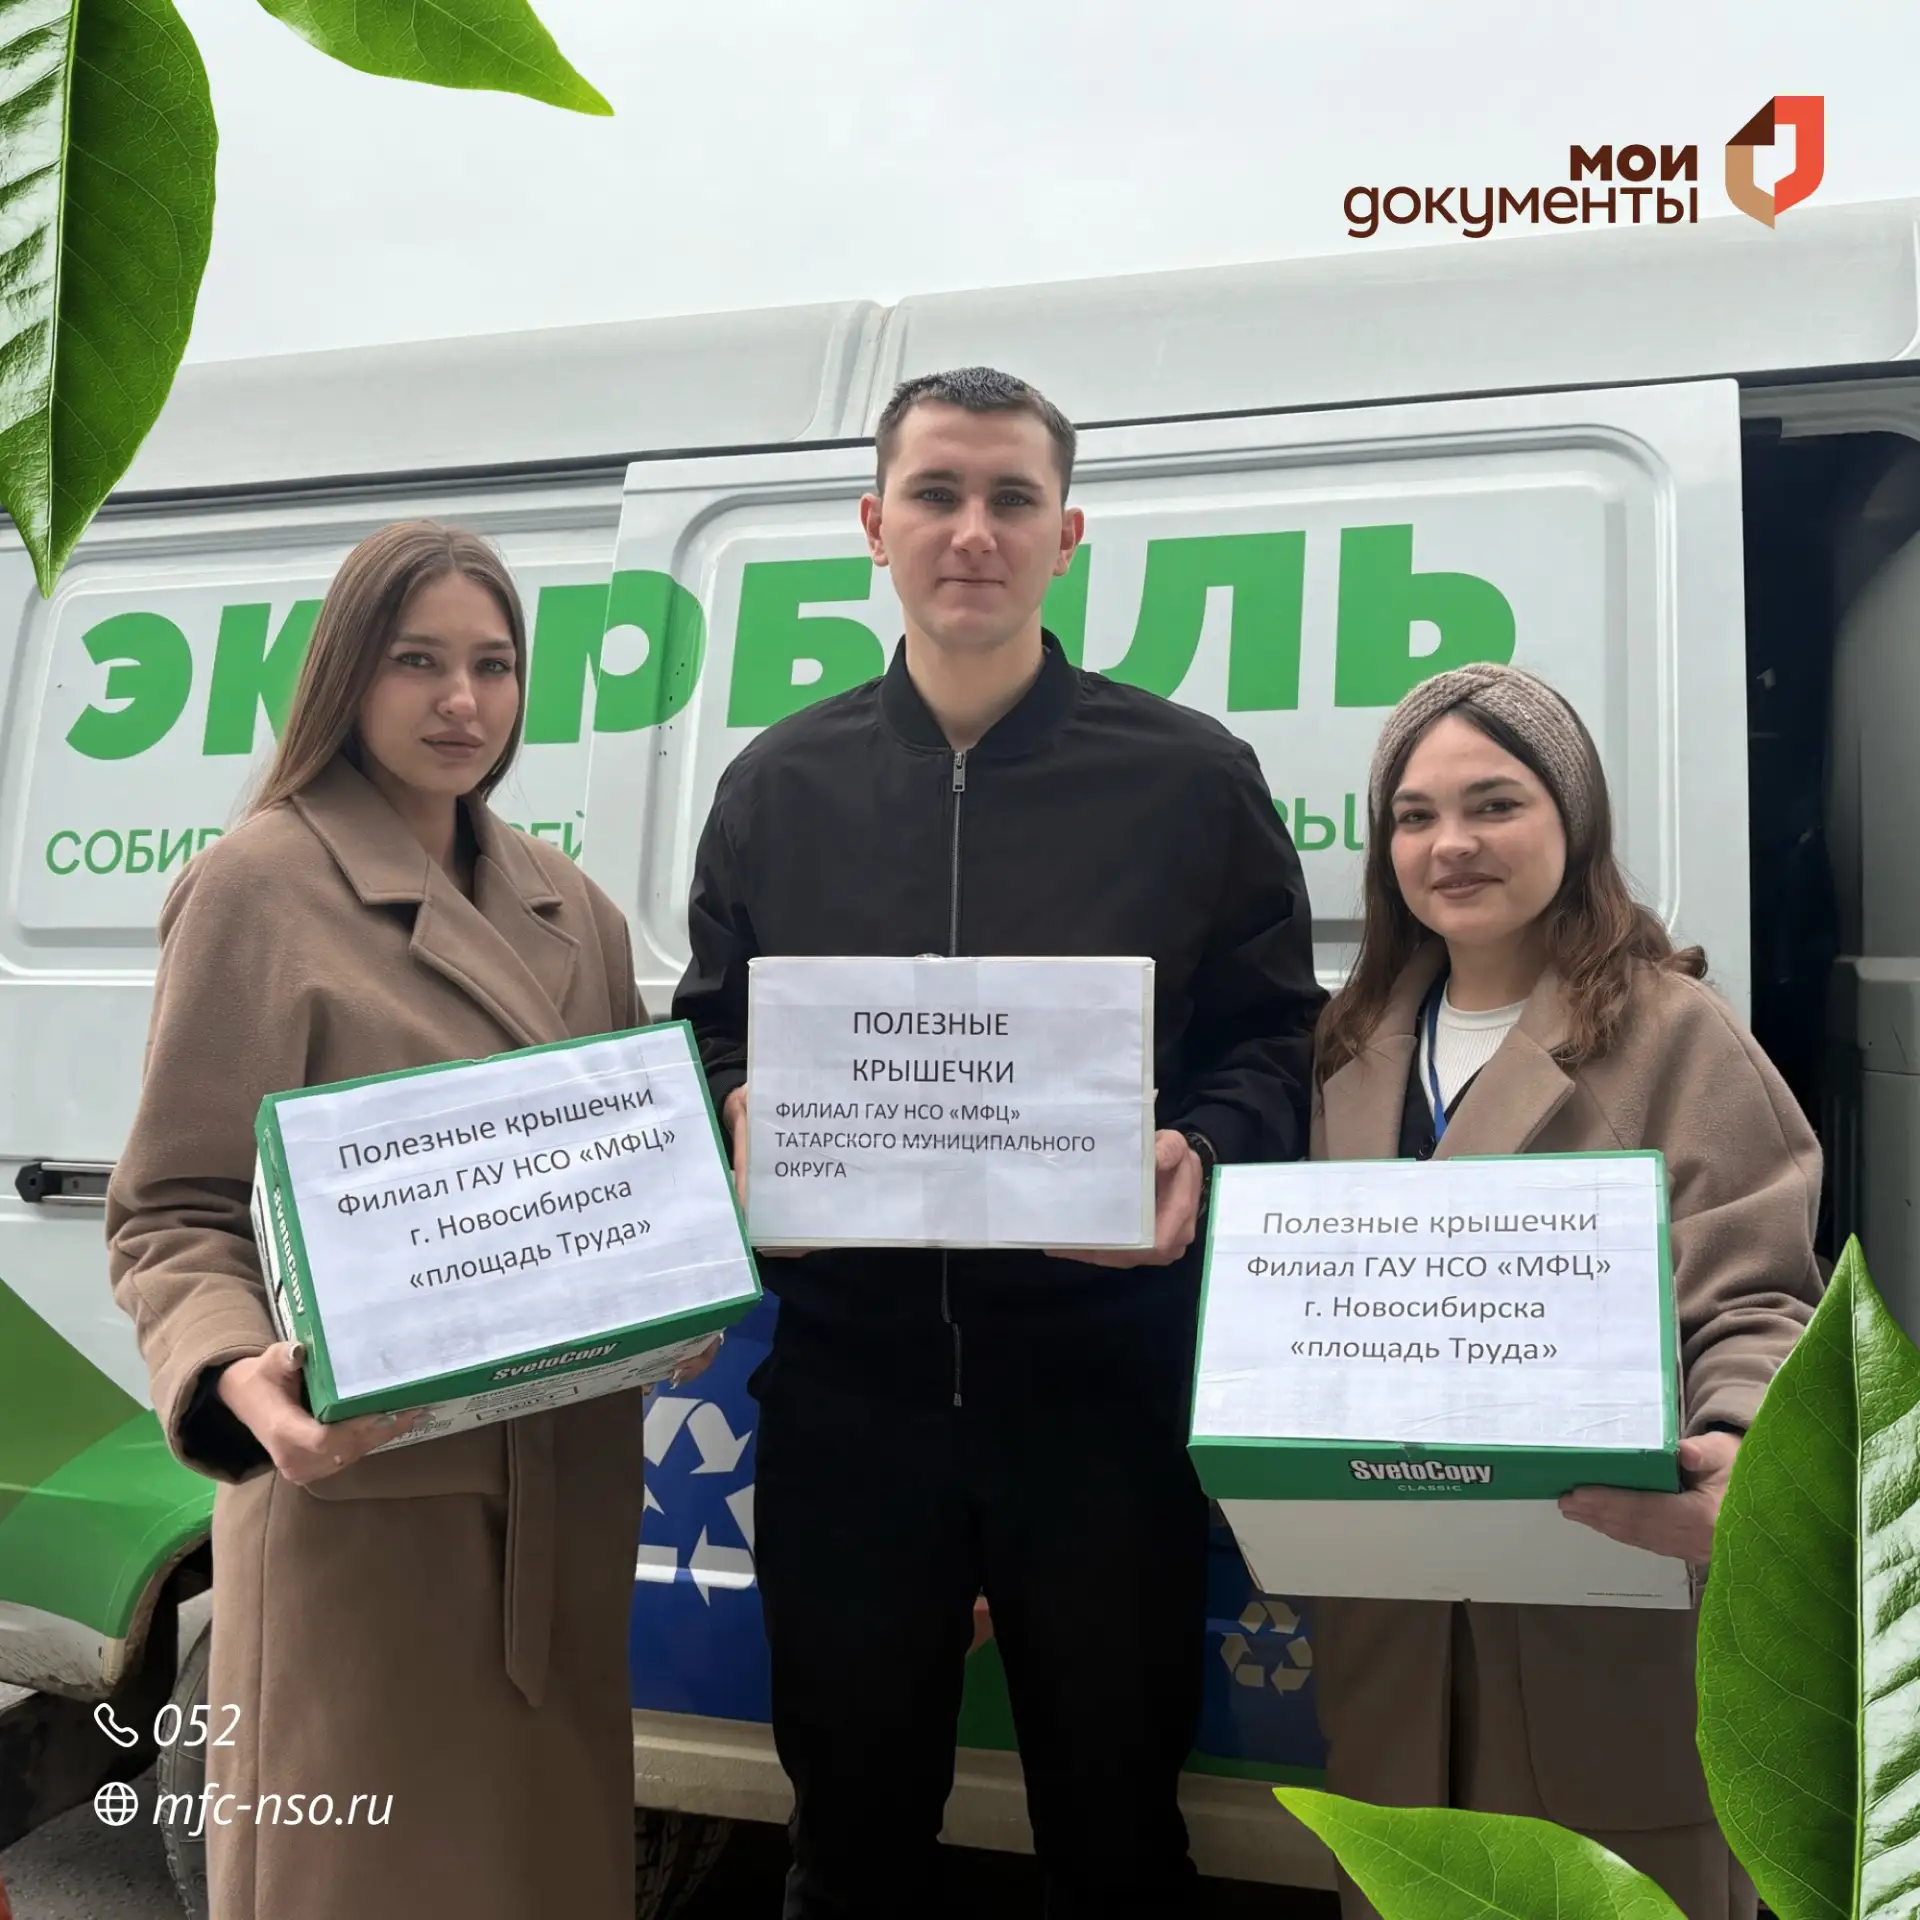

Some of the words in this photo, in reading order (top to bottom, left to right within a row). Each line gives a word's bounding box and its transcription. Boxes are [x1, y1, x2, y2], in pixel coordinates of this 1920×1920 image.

[853, 1011, 1009, 1036] ПОЛЕЗНЫЕ
[852, 1058, 1014, 1084] КРЫШЕЧКИ
[775, 1101, 859, 1120] ФИЛИАЛ
[865, 1102, 900, 1120] ГАУ
[904, 1103, 944, 1121] НСО
[949, 1104, 1021, 1125] «МФЦ»
[338, 1121, 497, 1170] Полезные
[504, 1084, 657, 1138] крышечки
[774, 1131, 897, 1150] ТАТАРСКОГО
[902, 1133, 1096, 1154] МУНИЦИПАЛЬНОГО
[337, 1178, 450, 1217] Филиал
[455, 1161, 505, 1192] ГАУ
[512, 1149, 571, 1180] НСО
[579, 1127, 676, 1163] «МФЦ»
[774, 1161, 848, 1179] ОКРУГА
[410, 1227, 430, 1247] г.
[436, 1180, 633, 1240] Новосибирска
[1263, 1212, 1419, 1235] Полезные
[1430, 1213, 1597, 1240] крышечки
[409, 1243, 552, 1289] «площадь
[555, 1219, 651, 1258] Труда»
[1247, 1255, 1355, 1278] Филиал
[1365, 1256, 1417, 1278] ГАУ
[1425, 1255, 1487, 1278] НСО
[1497, 1254, 1611, 1281] «МФЦ»
[1304, 1300, 1322, 1317] г.
[1332, 1295, 1545, 1324] Новосибирска
[491, 1342, 618, 1382] SvetoCopy
[1290, 1340, 1441, 1364] «площадь
[1448, 1336, 1558, 1366] Труда»
[1350, 1459, 1492, 1484] SvetoCopy
[1397, 1484, 1462, 1492] CLASSIC
